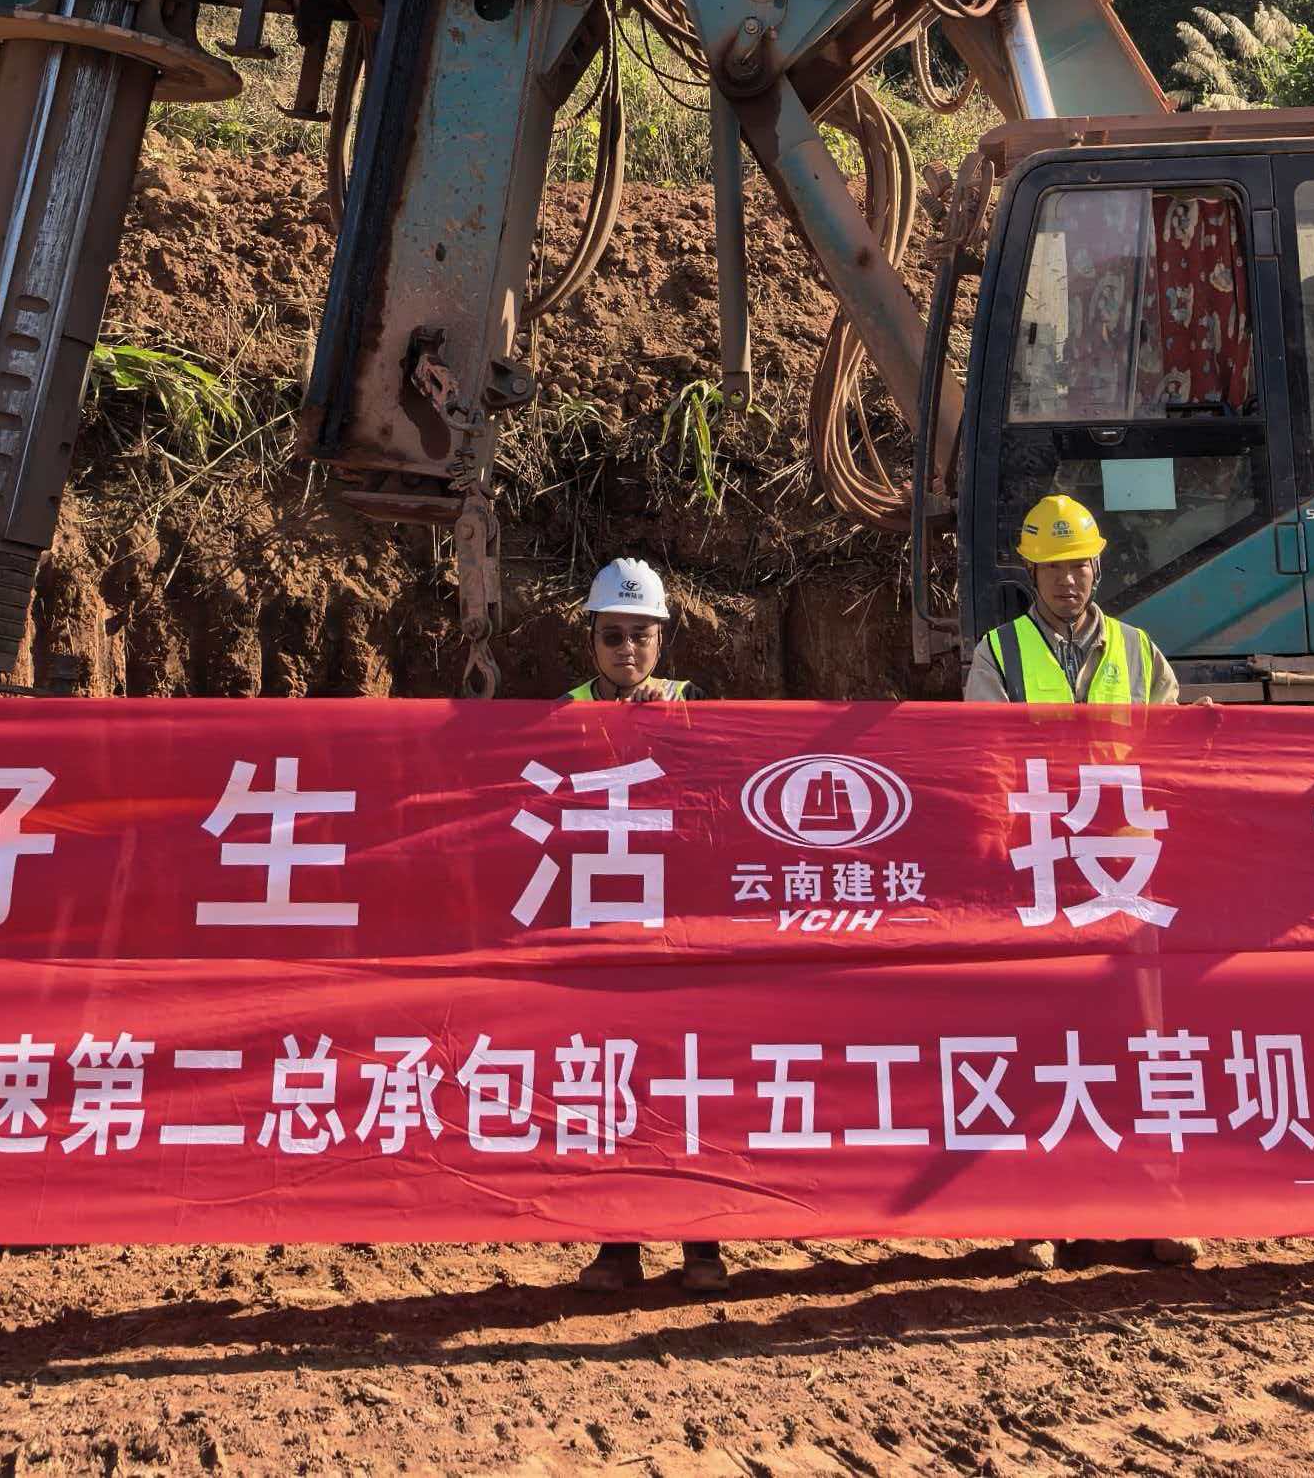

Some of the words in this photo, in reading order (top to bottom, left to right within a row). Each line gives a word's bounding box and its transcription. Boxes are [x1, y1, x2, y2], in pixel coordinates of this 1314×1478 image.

[731, 861, 927, 903] 云南建投
[777, 909, 884, 932] YCIH
